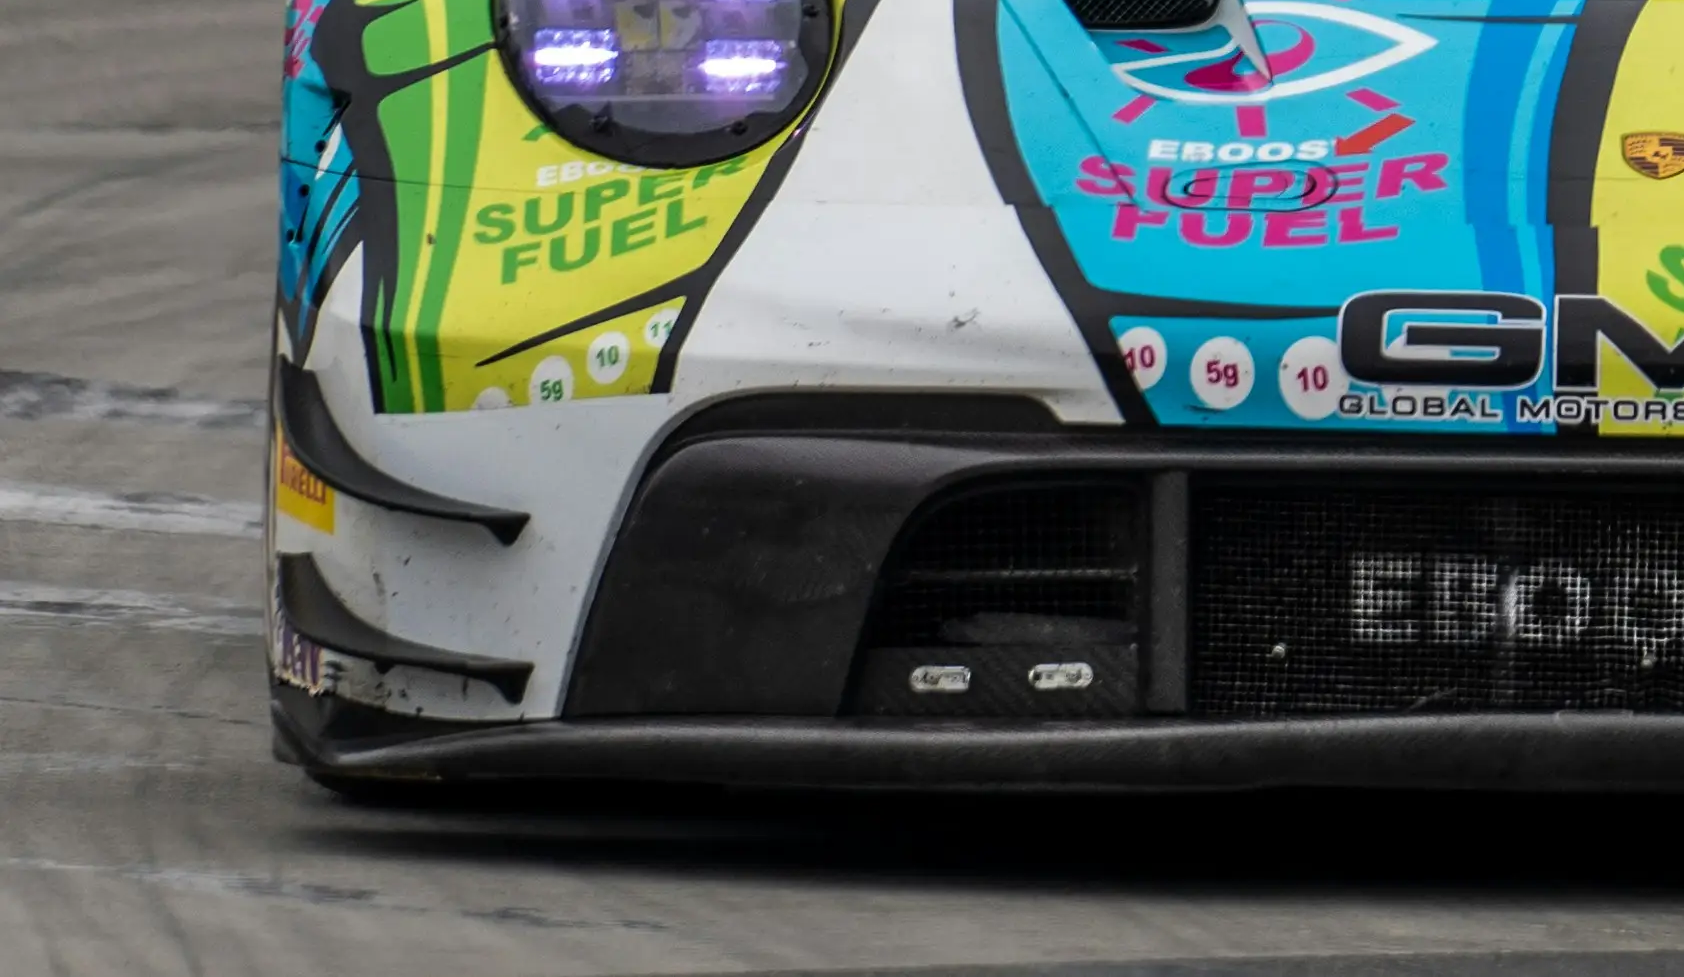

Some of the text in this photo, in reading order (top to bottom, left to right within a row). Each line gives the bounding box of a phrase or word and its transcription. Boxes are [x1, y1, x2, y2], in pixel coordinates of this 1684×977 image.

[1147, 139, 1338, 163] EBOOS
[1075, 153, 1450, 207] SUPER
[473, 155, 750, 245] SUPER
[1111, 202, 1400, 248] FUEL
[500, 196, 708, 285] FUEL
[595, 345, 620, 367] 10
[1206, 359, 1240, 387] 5g
[1296, 364, 1330, 392] 10
[539, 378, 564, 401] 5g
[1337, 394, 1502, 421] GLOBAL
